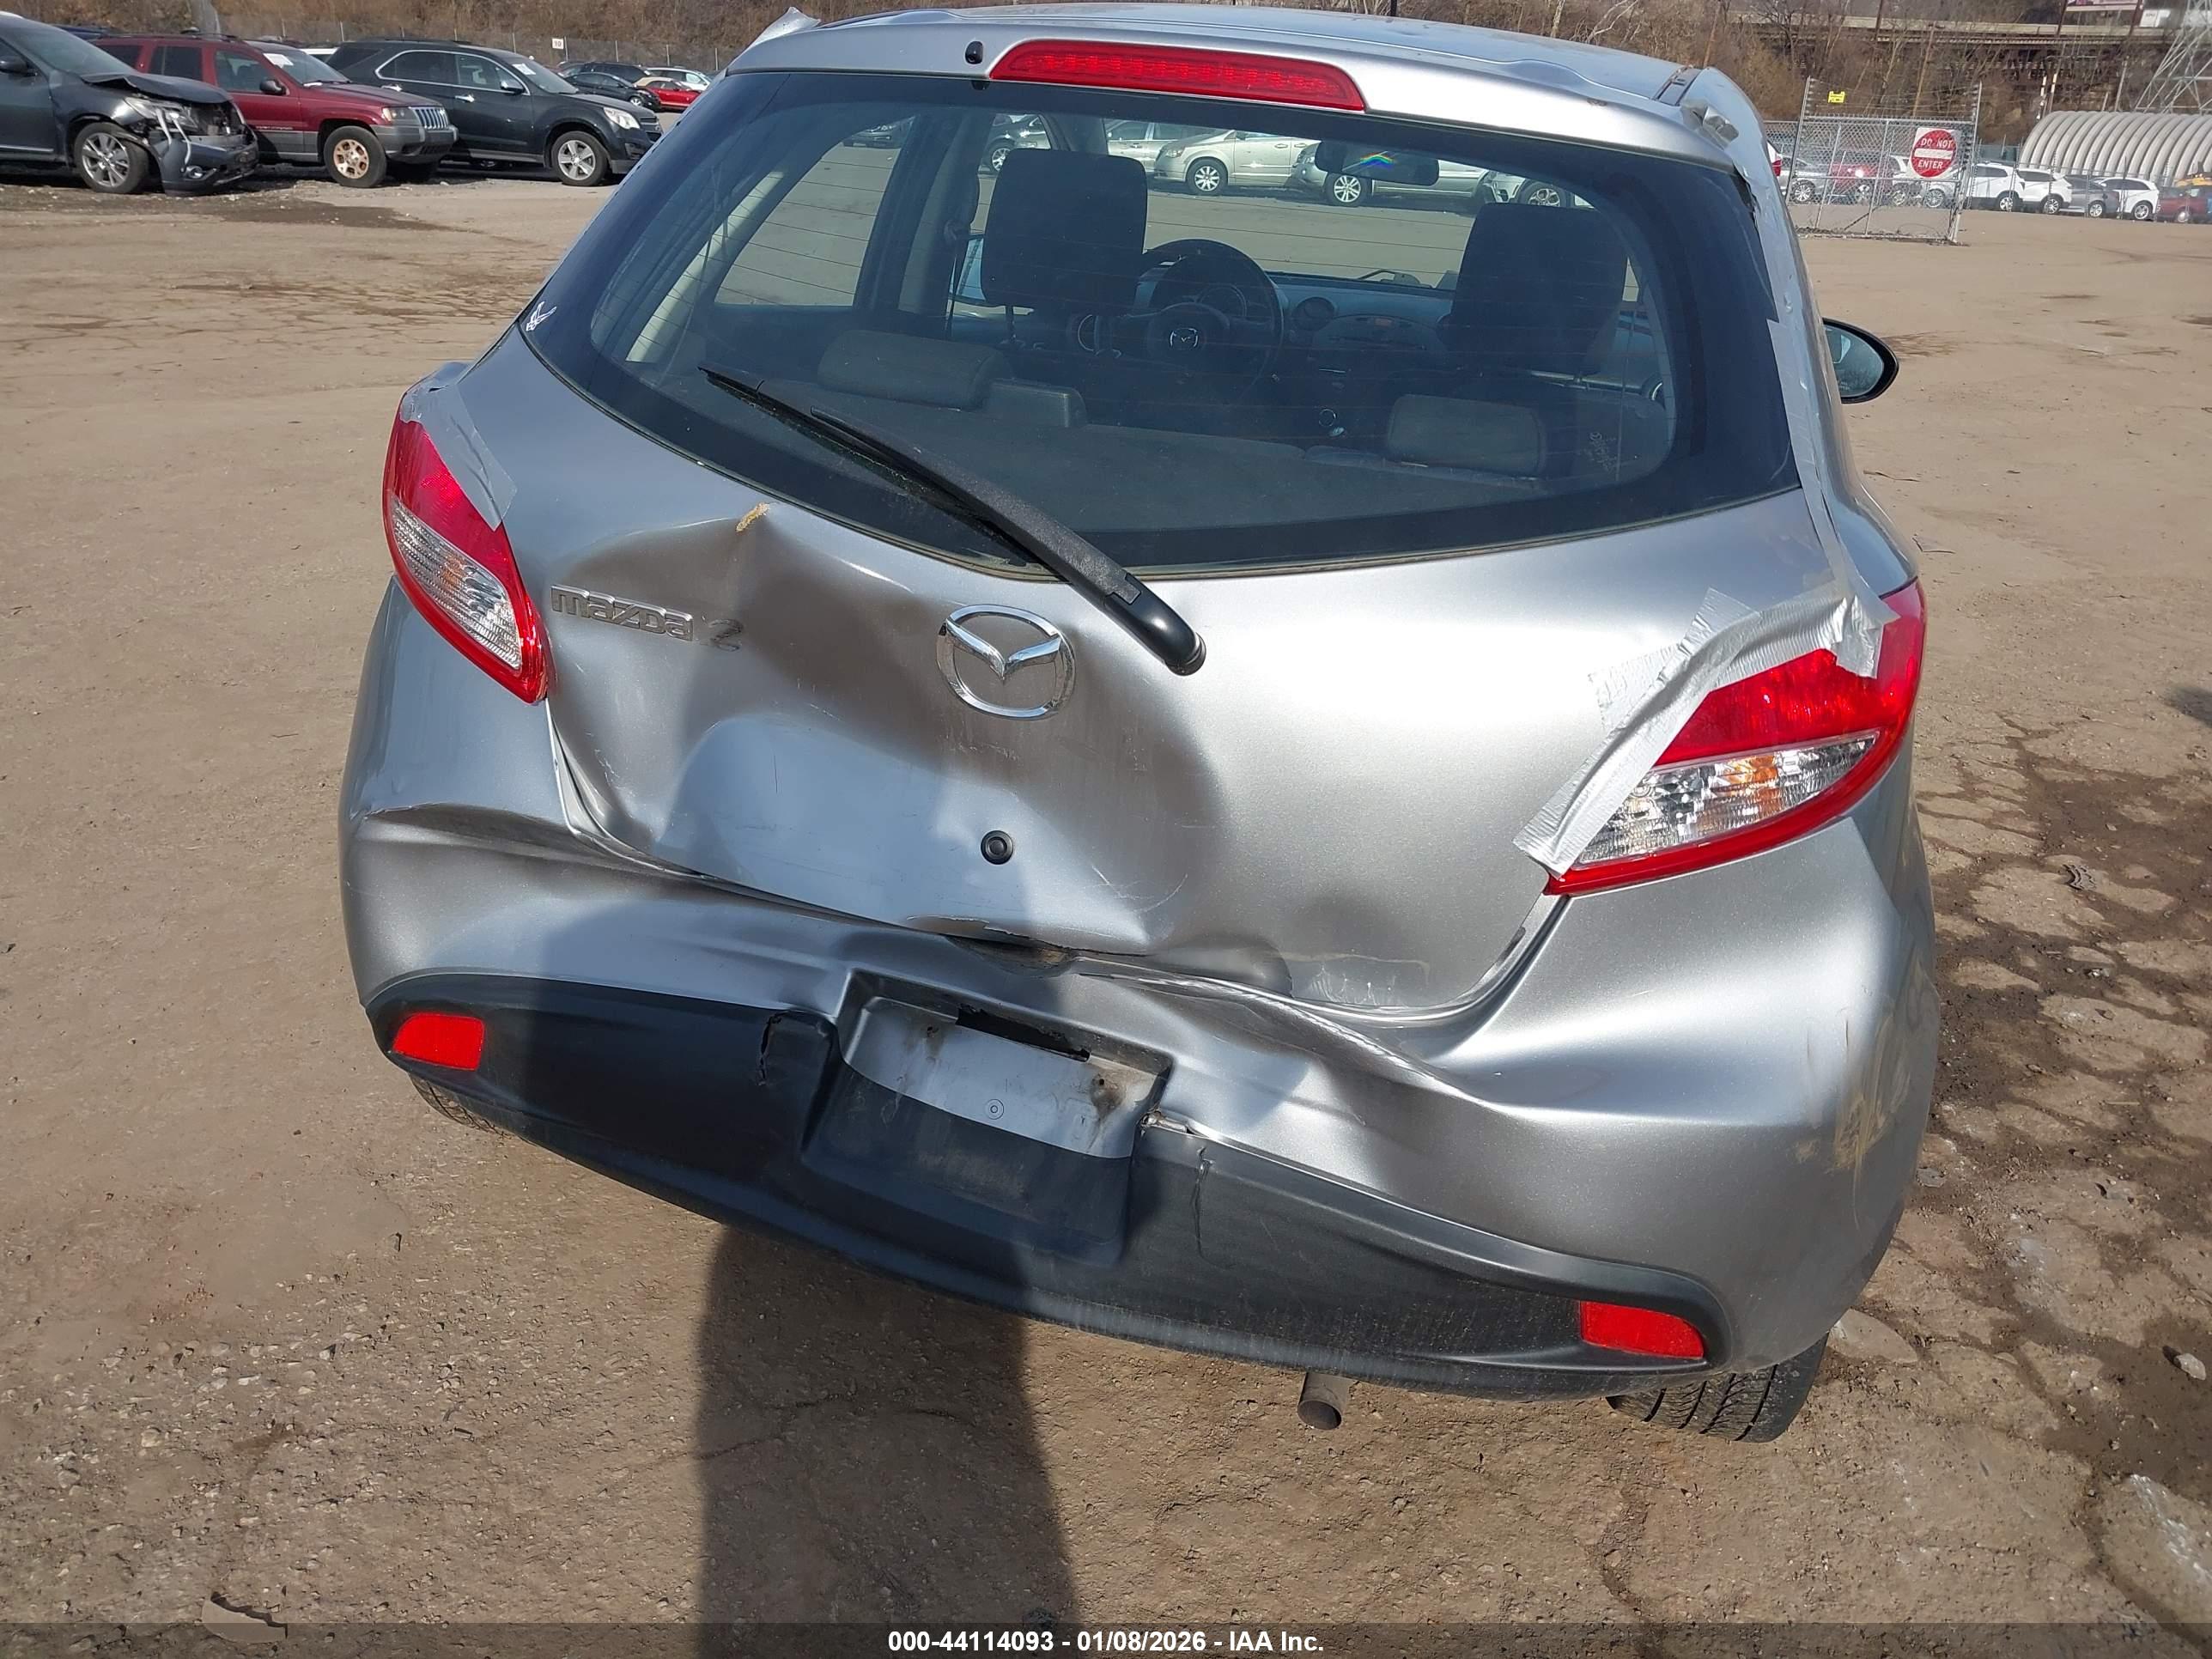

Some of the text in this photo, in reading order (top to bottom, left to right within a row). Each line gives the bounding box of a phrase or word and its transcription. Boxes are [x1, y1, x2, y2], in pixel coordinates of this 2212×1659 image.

[1921, 137, 1954, 149] DO NOT
[1917, 160, 1943, 169] ENTER
